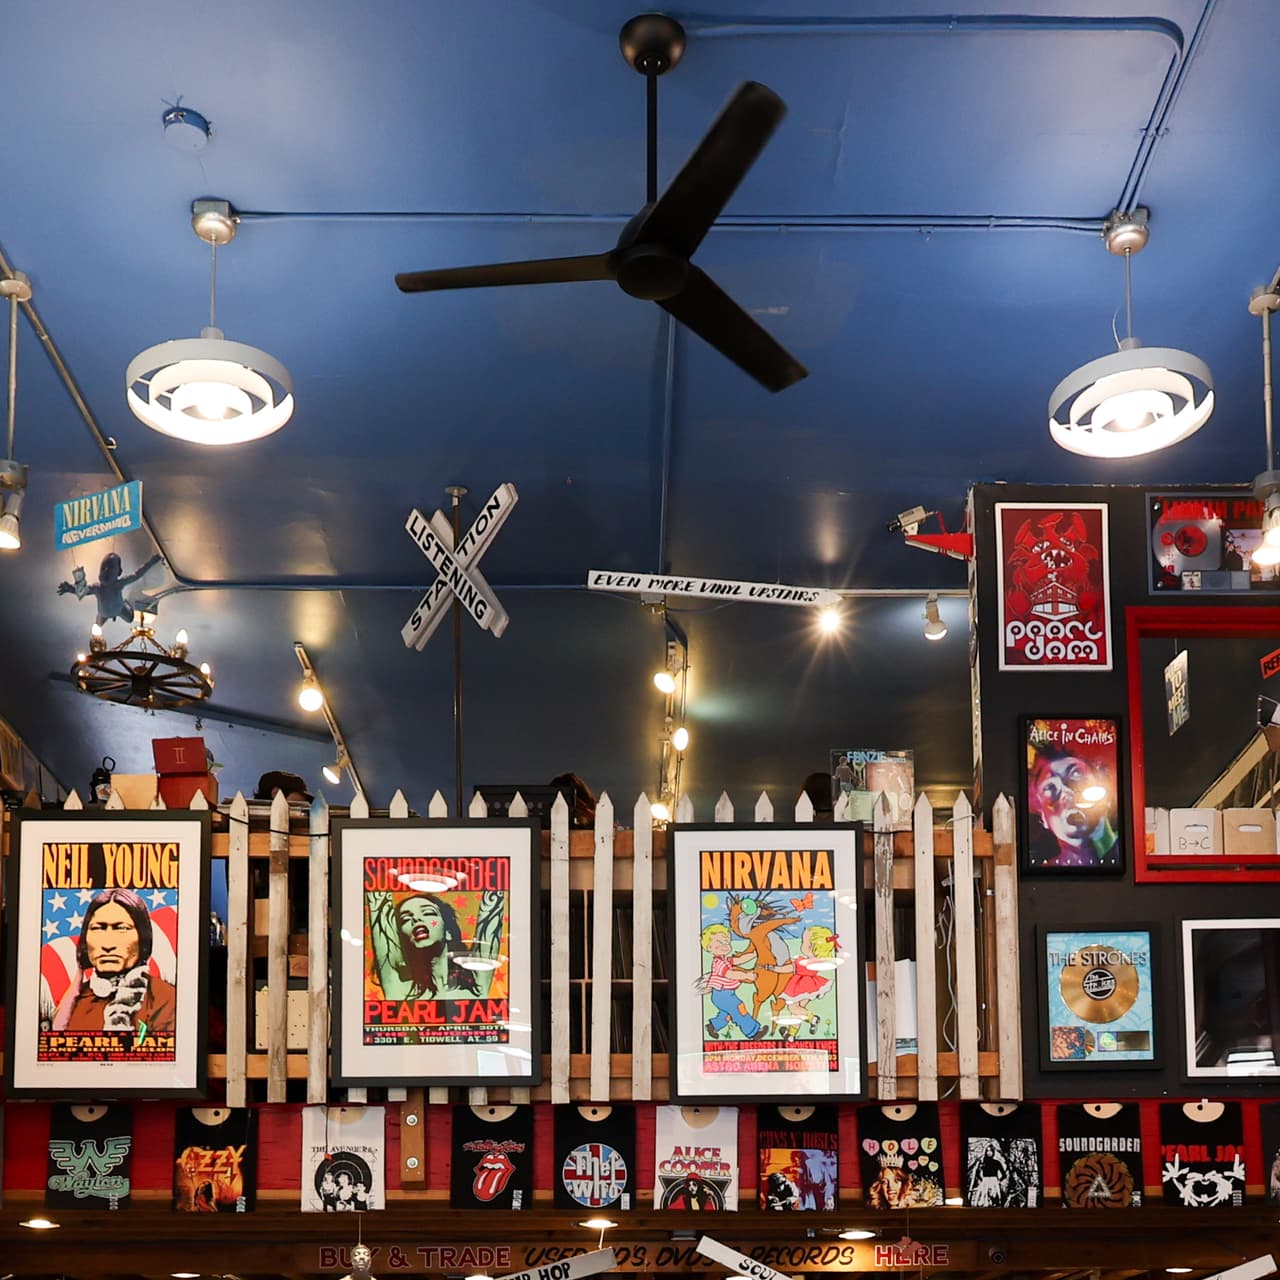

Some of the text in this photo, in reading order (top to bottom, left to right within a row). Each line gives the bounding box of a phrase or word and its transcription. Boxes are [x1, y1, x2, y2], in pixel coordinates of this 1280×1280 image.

[62, 485, 132, 531] NIRVANA
[61, 514, 132, 544] NEVERMIND
[408, 514, 488, 620] LISTENING
[593, 574, 820, 604] EVEN MORE VINYL UPSTAIRS
[42, 844, 179, 889] NEIL YOUNG
[701, 851, 832, 891] NIRVANA
[1049, 950, 1148, 968] THE STROKES
[364, 1001, 508, 1024] PEARL JAM
[50, 1036, 175, 1047] PEARL JAM
[671, 1145, 722, 1163] ALICE
[1059, 1137, 1141, 1152] SOUNDGARDEN
[658, 1160, 731, 1177] COOPER
[388, 1248, 409, 1268] &
[417, 1247, 511, 1268] TRADE
[875, 1244, 950, 1267] HERE
